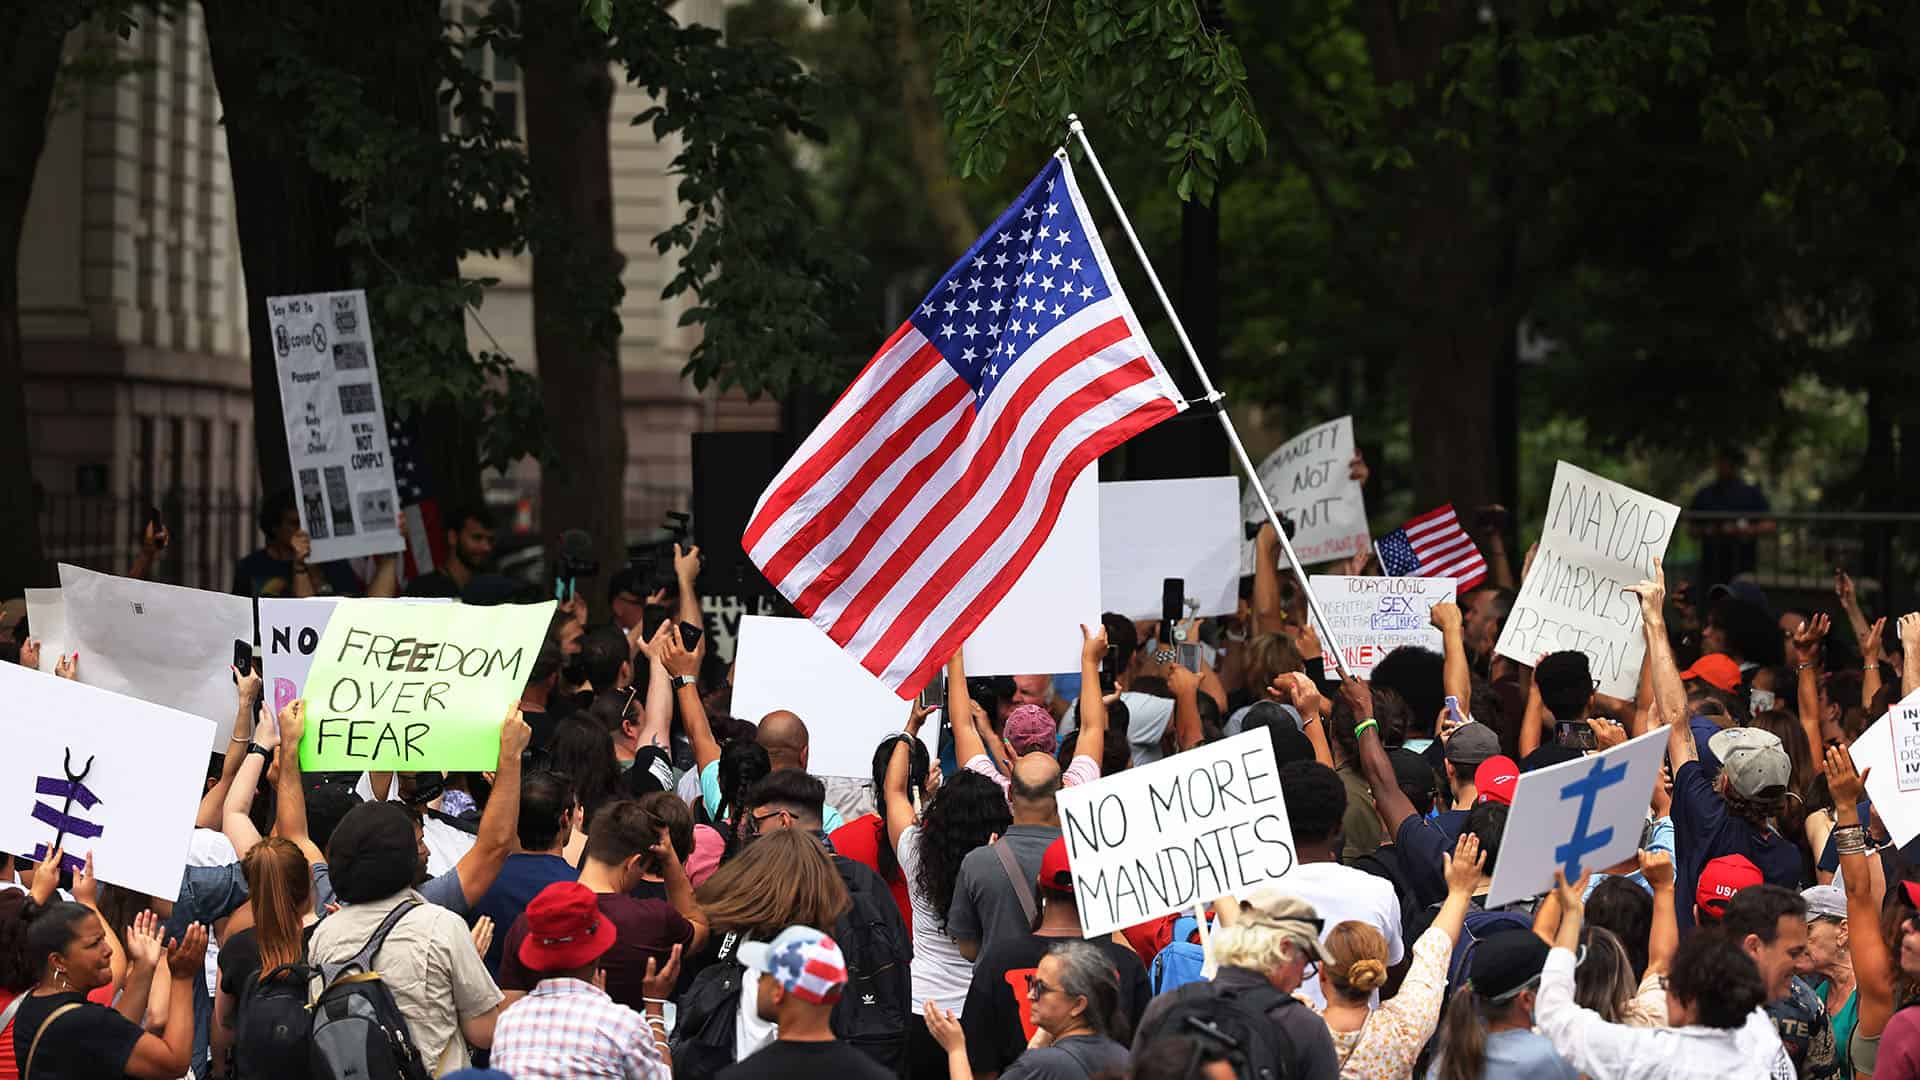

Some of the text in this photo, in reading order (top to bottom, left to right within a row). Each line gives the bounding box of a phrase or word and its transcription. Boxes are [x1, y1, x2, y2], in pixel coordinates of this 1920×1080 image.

[351, 451, 384, 471] COMPLY
[355, 434, 374, 451] NOT
[1292, 458, 1338, 495] NOT
[1552, 481, 1666, 580] MAYOR
[1379, 596, 1414, 615] SEX
[271, 626, 319, 655] NO
[338, 626, 523, 680] FREEDOM
[329, 677, 451, 713] OVER
[318, 718, 430, 761] FEAR
[1065, 748, 1278, 859] NO MORE
[1078, 814, 1293, 930] MANDATES
